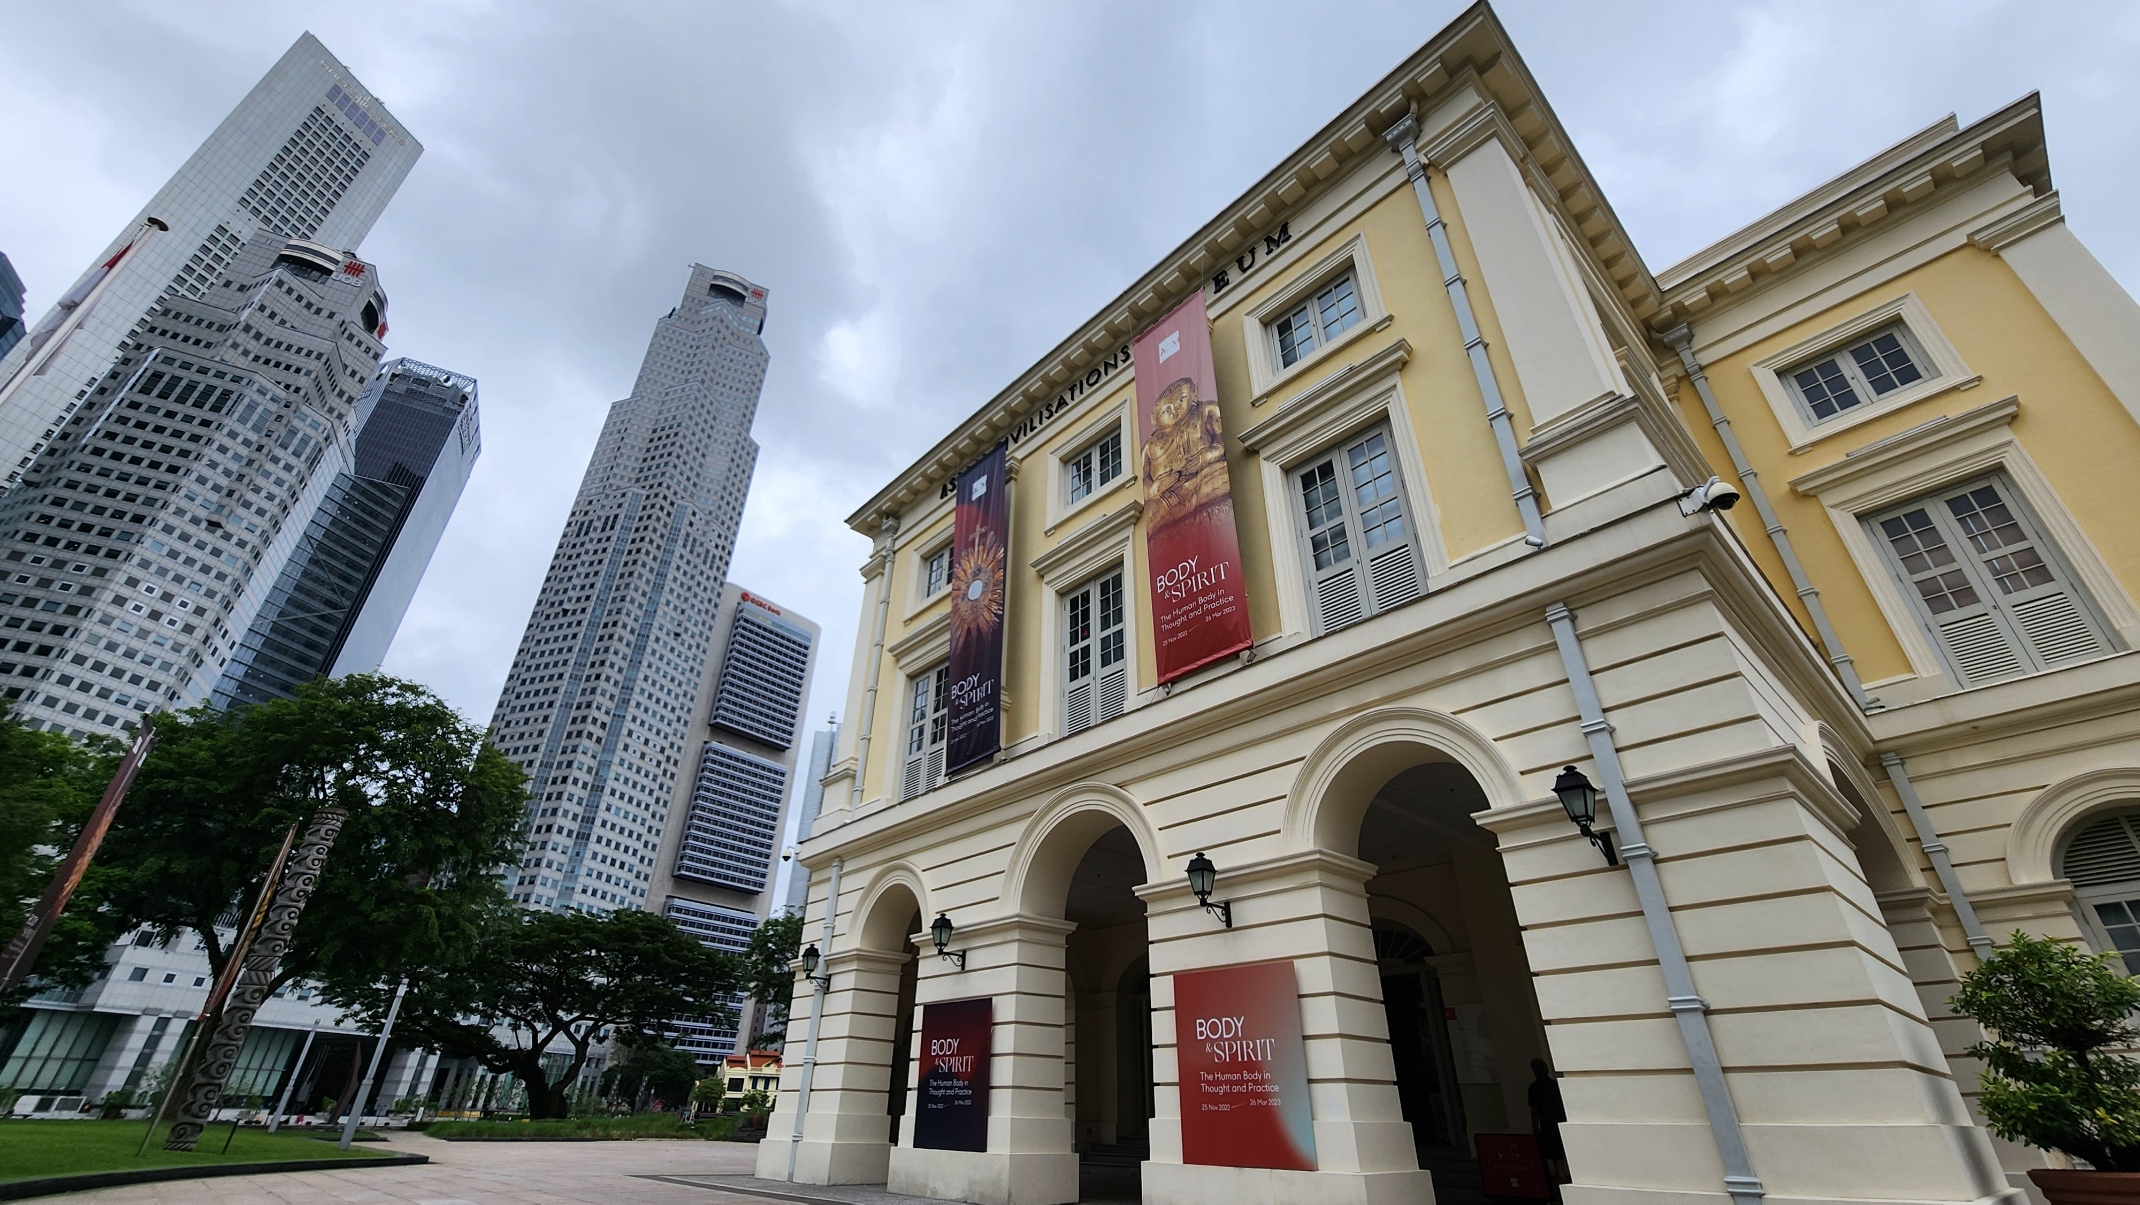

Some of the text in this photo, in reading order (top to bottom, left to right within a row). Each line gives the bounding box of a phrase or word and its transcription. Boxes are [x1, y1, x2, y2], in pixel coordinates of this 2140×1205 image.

[1211, 221, 1292, 294] EUM
[331, 271, 363, 288] UOB
[1003, 344, 1131, 452] IVILISATIONS
[1156, 555, 1198, 593] BODY
[1171, 562, 1230, 602] SPIRIT
[1160, 588, 1225, 623] The Human Body in
[1161, 595, 1234, 632] Thought and Practice
[951, 673, 980, 700] BODY
[960, 679, 994, 710] SPIRIT
[1196, 1016, 1244, 1040] BODY
[931, 1038, 960, 1056] BODY
[1213, 1038, 1276, 1063] SPIRIT
[939, 1055, 974, 1073] SPIRIT
[1200, 1070, 1271, 1082] The Human Body in
[1200, 1082, 1280, 1095] Thought and Practice
[1257, 1098, 1268, 1106] Mar
